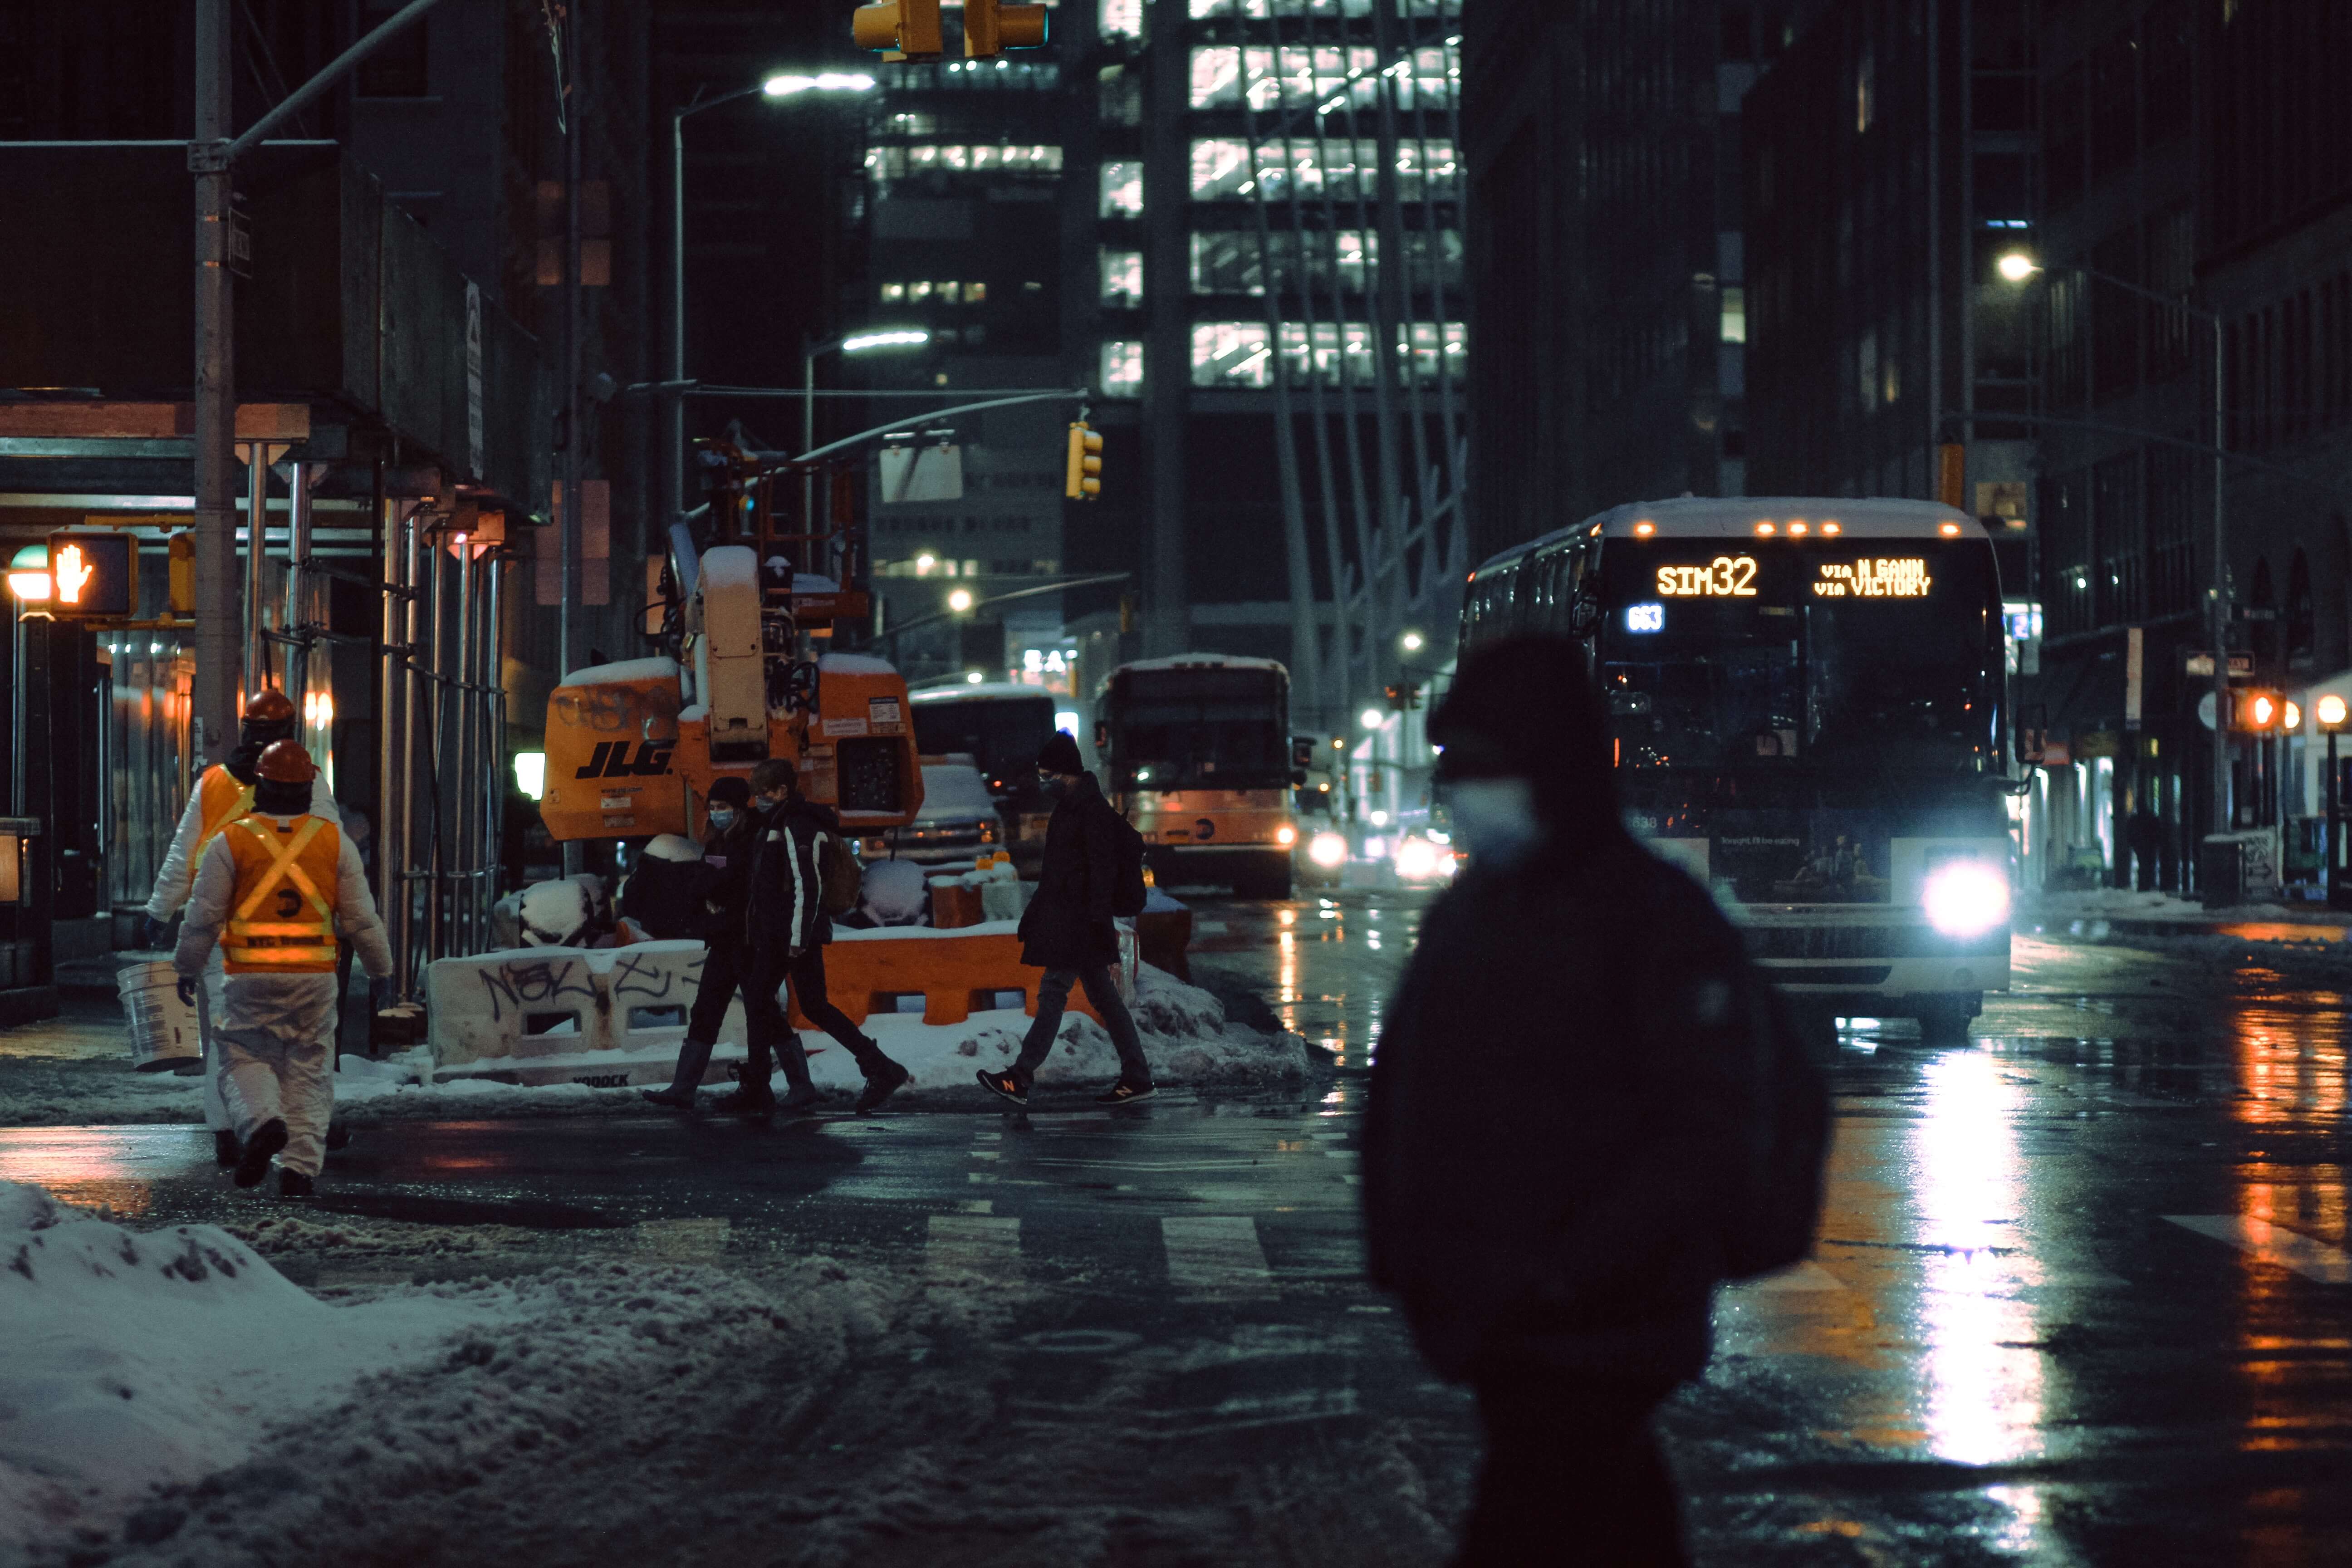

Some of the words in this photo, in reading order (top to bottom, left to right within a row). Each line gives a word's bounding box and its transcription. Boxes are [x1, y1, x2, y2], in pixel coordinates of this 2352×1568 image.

[1658, 557, 1757, 595] SIM32
[1822, 565, 1852, 578] VIA
[1857, 559, 1871, 578] N
[1876, 559, 1924, 578] GANN
[1814, 583, 1845, 596] VIA
[1851, 577, 1931, 596] VICTORY
